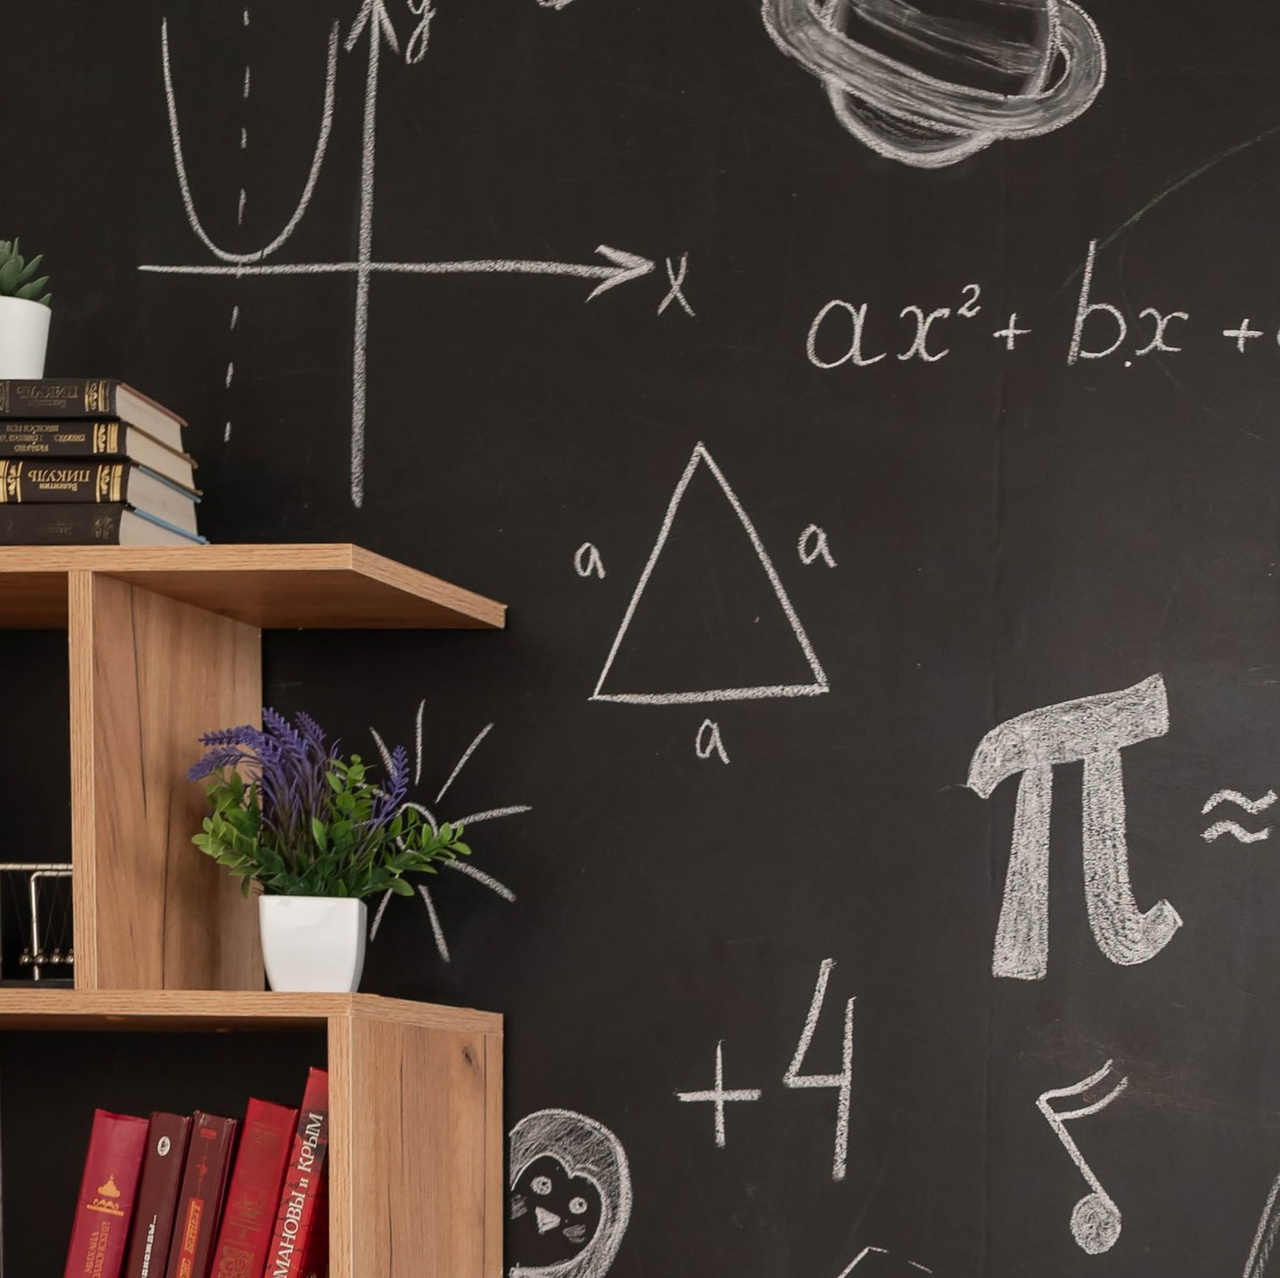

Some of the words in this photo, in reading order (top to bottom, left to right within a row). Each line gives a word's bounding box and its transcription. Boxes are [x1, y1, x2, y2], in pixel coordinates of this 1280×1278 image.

[27, 469, 91, 484] ПИКУЛЬ
[38, 482, 78, 492] Валентин
[573, 542, 606, 580] a
[798, 523, 837, 568] a
[695, 719, 730, 764] a
[297, 1112, 324, 1174] КРЫМ
[299, 1177, 309, 1189] и
